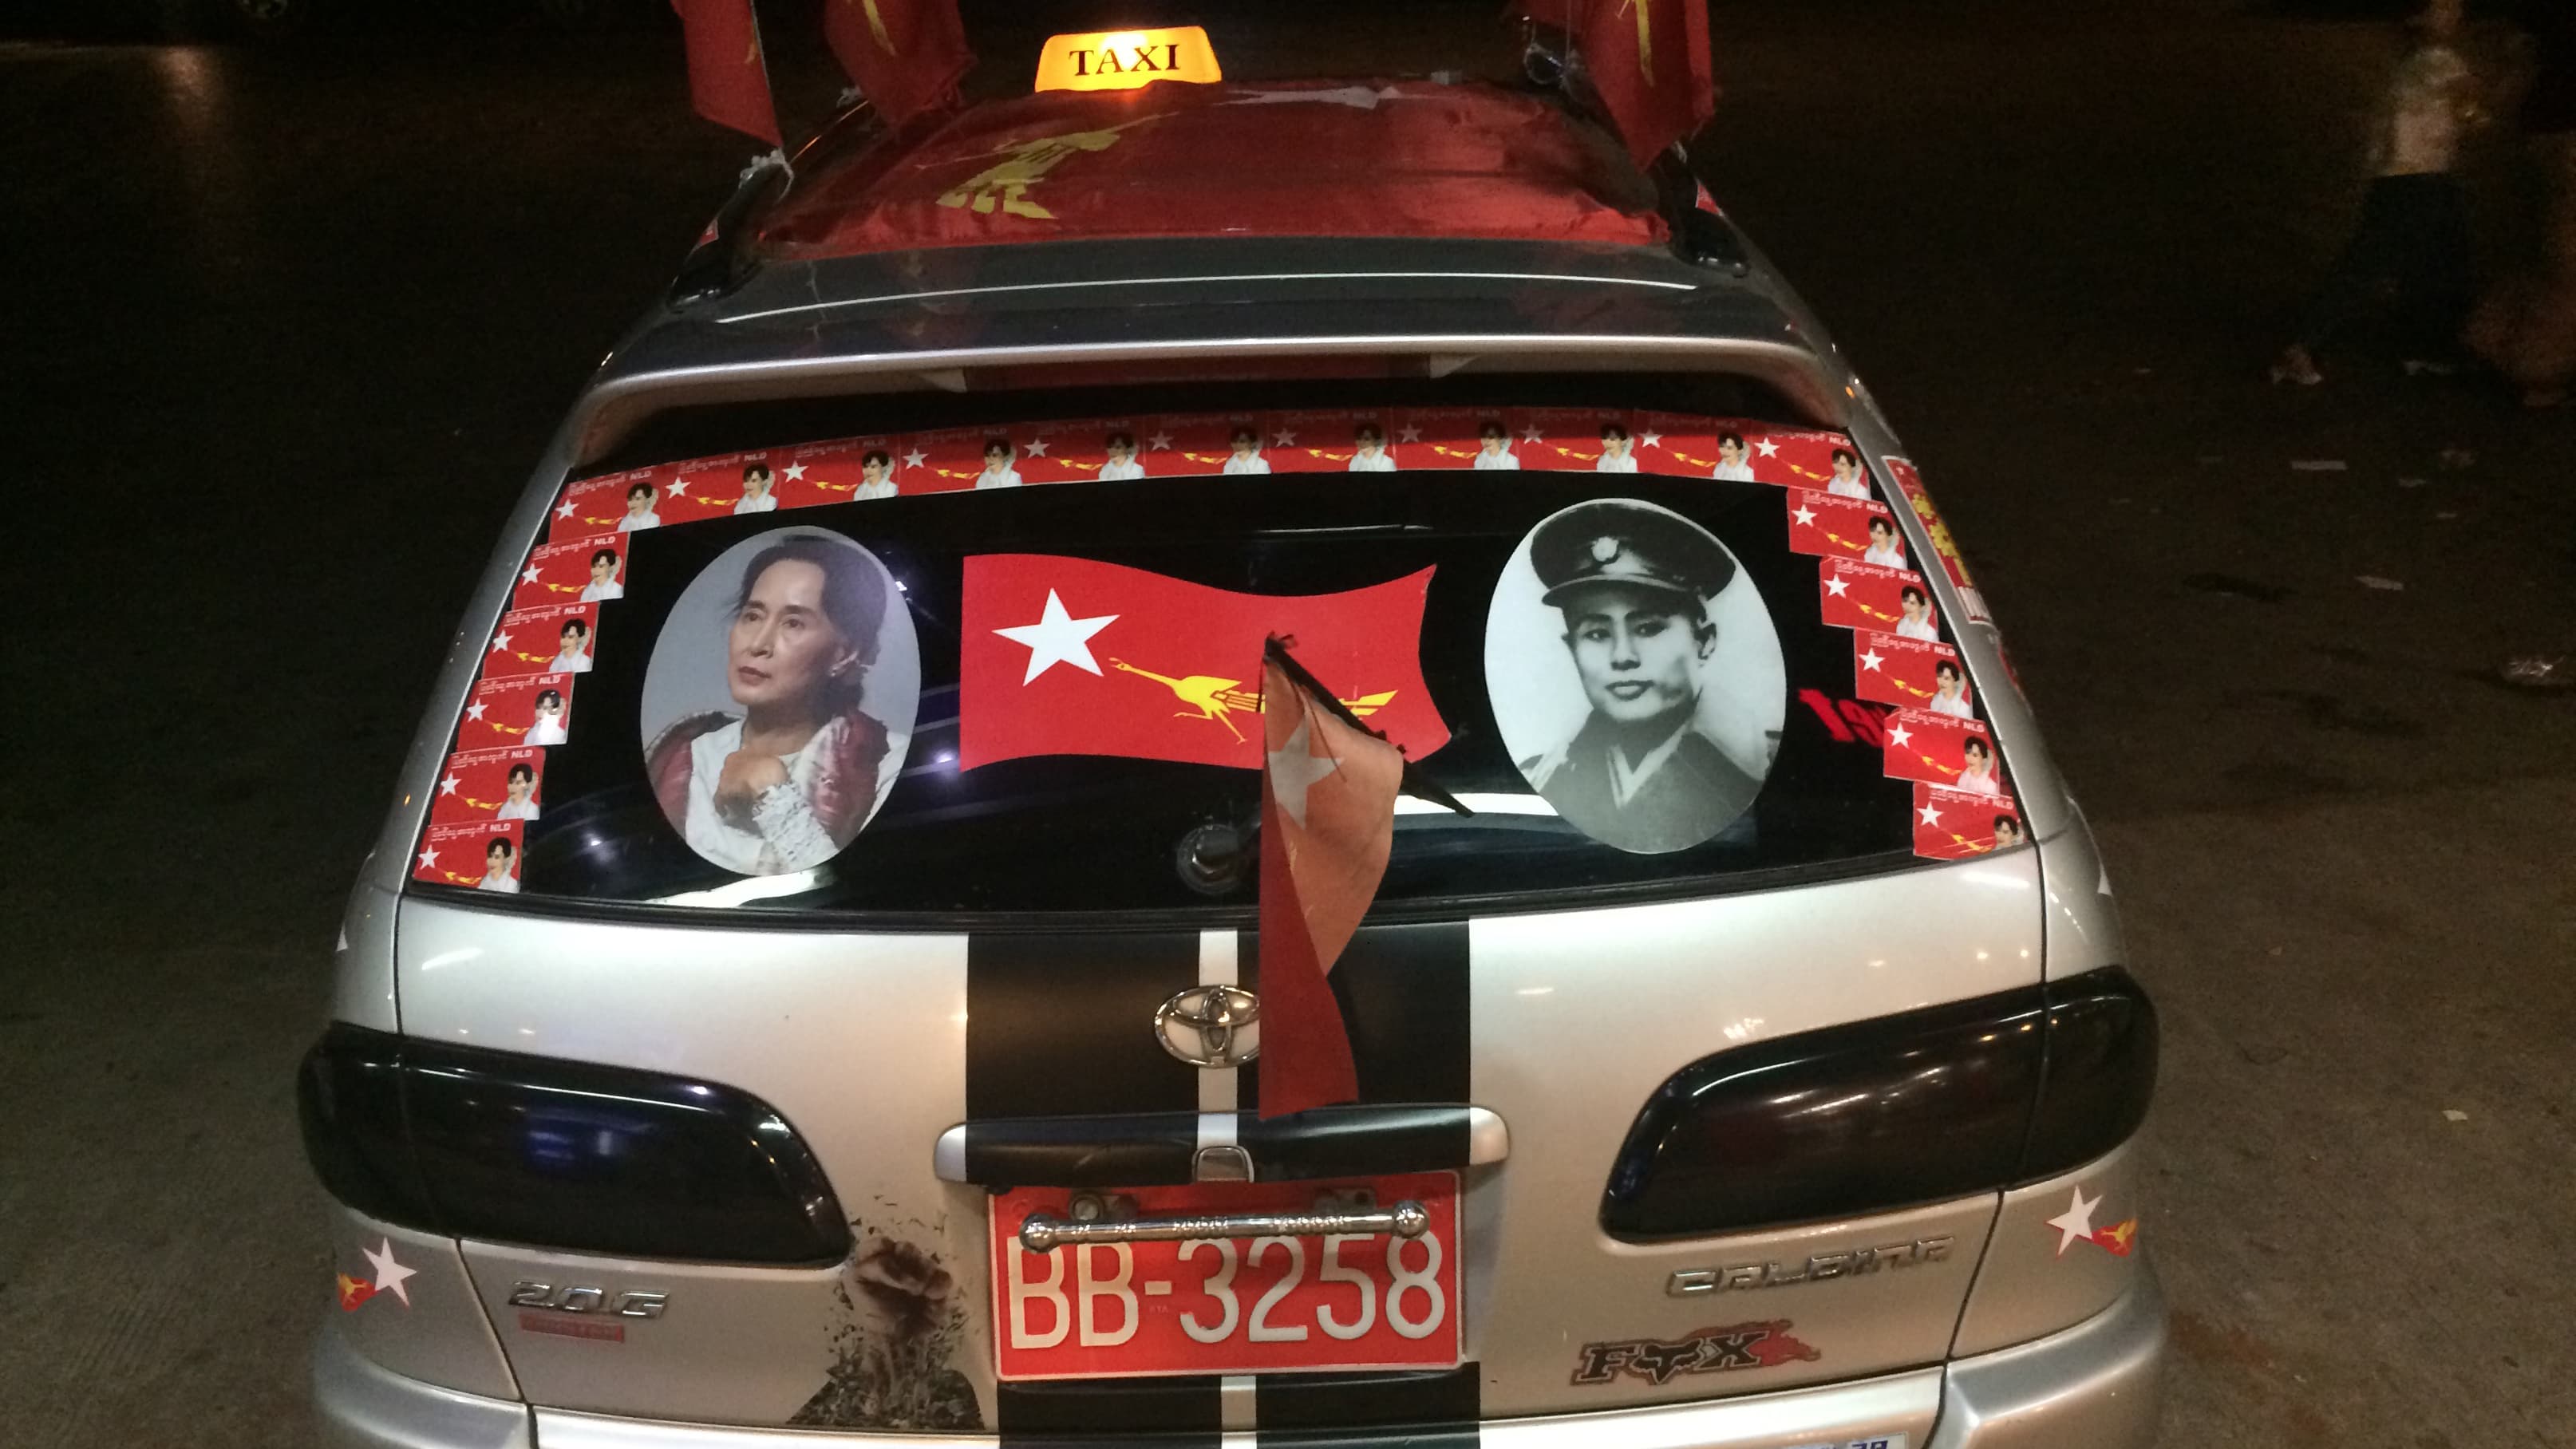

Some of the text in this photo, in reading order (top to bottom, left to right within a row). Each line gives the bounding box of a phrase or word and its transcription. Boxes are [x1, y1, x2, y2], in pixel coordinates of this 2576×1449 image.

[1068, 44, 1180, 77] TAXI
[594, 535, 616, 546] NLD
[564, 606, 587, 615] NLD
[1934, 646, 1956, 657] NLD
[511, 749, 533, 759] NLD
[489, 823, 512, 832] NLD
[1006, 1230, 1446, 1350] BB-3258
